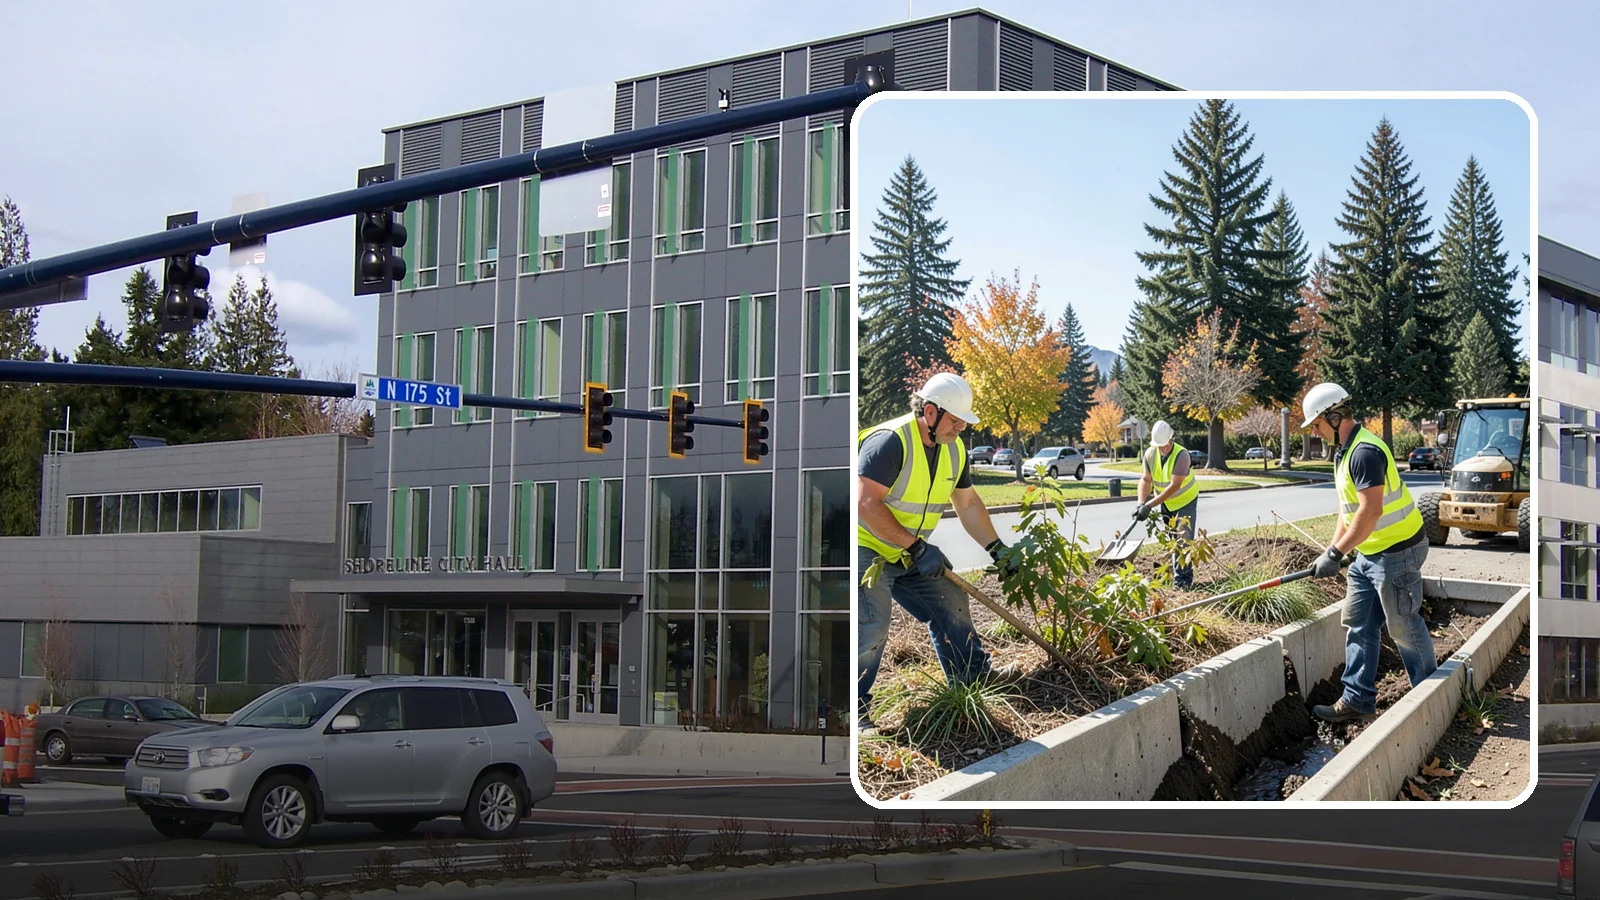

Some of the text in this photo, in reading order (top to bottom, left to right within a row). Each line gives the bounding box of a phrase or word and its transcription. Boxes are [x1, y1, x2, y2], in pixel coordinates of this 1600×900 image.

[387, 380, 452, 406] N 175 St
[344, 555, 526, 574] SHORELINE CITY HALL
